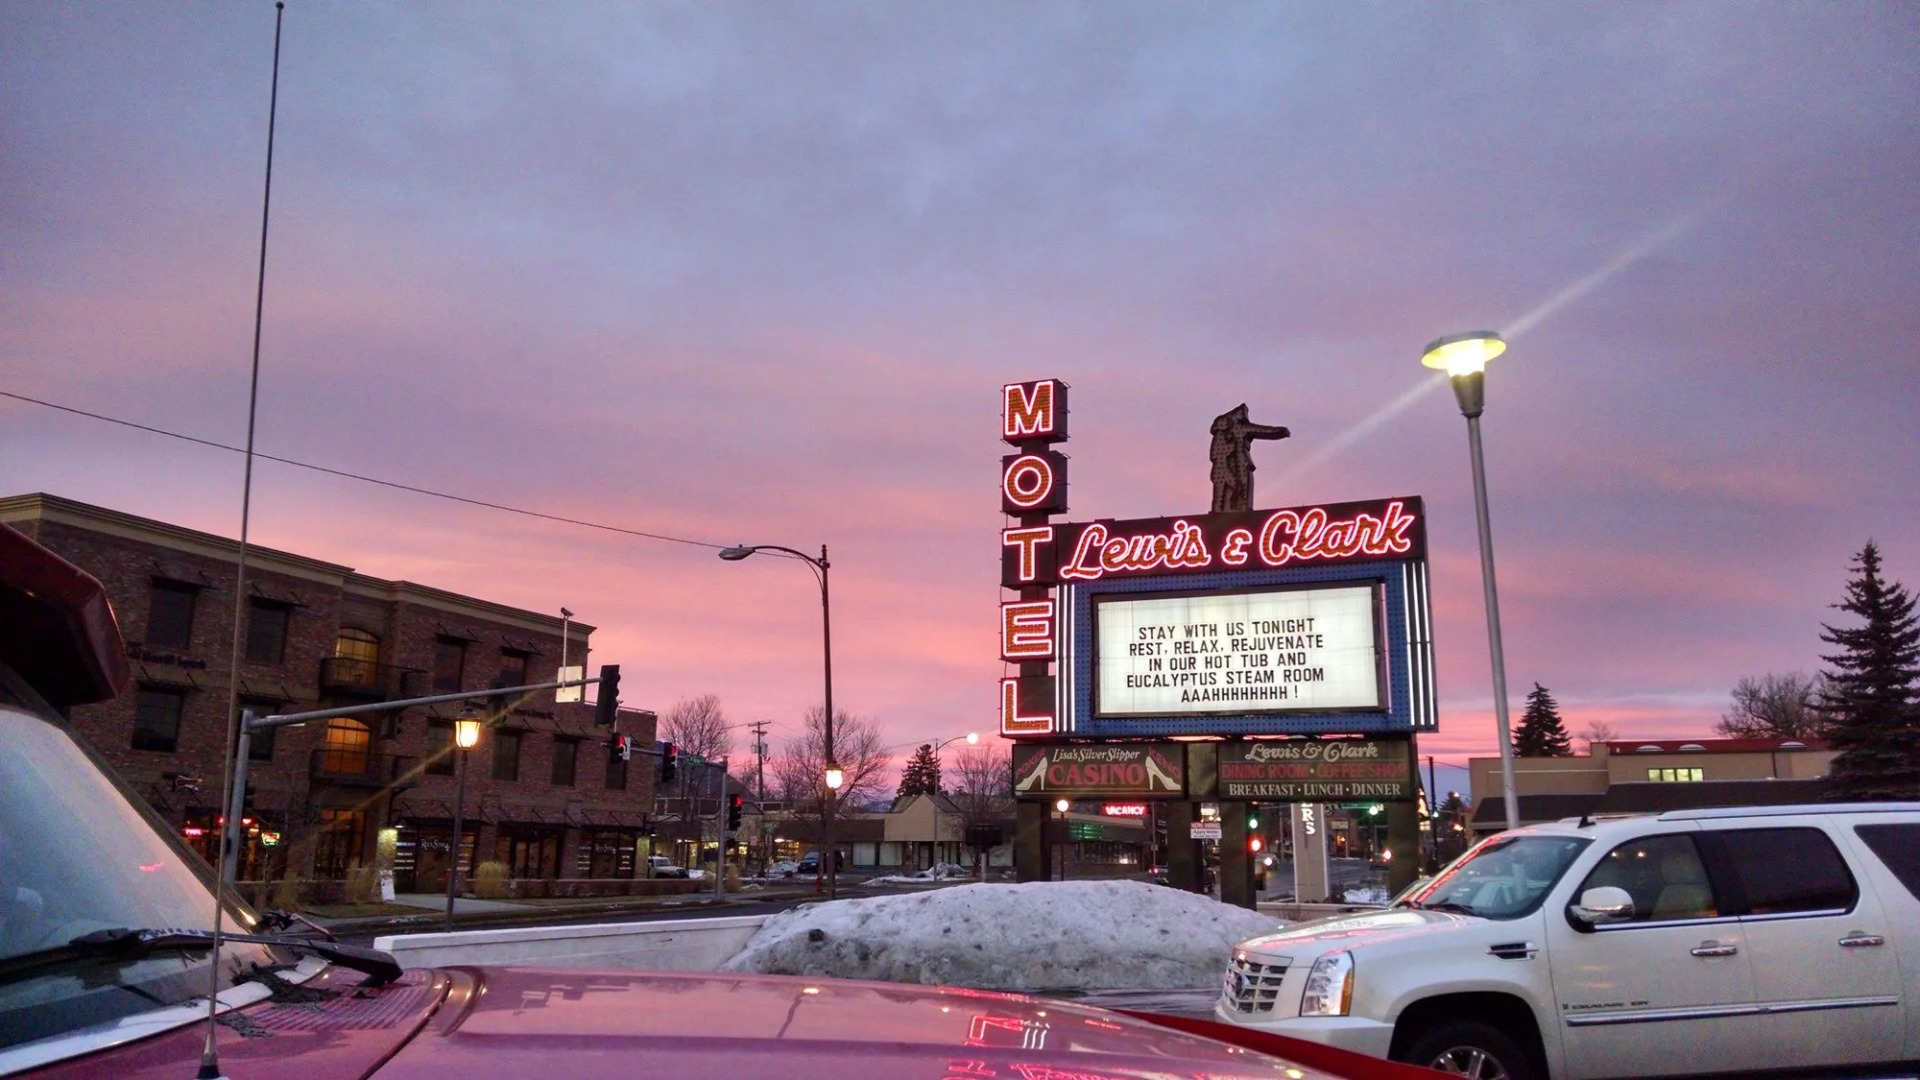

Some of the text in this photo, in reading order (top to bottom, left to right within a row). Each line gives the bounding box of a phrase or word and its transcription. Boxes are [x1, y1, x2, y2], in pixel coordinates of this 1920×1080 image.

[1060, 501, 1416, 580] Lewis & Clark
[1002, 379, 1054, 735] MOTEL
[1138, 617, 1316, 640] STAY WITH US TONIGHT
[1129, 634, 1324, 656] REST, RELAX, REJUVENATE
[1149, 651, 1307, 671] IN OUR HOT TUB AND
[1126, 667, 1325, 688] EUCALYPTUS STEAM ROOM
[1052, 748, 1141, 762] Lisa's Silver Slipper
[1245, 741, 1379, 763] Lewis & Clark
[1048, 764, 1145, 785] CASINO
[1222, 762, 1406, 779] DINING ROOM COFFEE SHOP
[1229, 783, 1402, 796] BREAKFAST LUNCH DINNER
[1105, 805, 1146, 816] VACANCY
